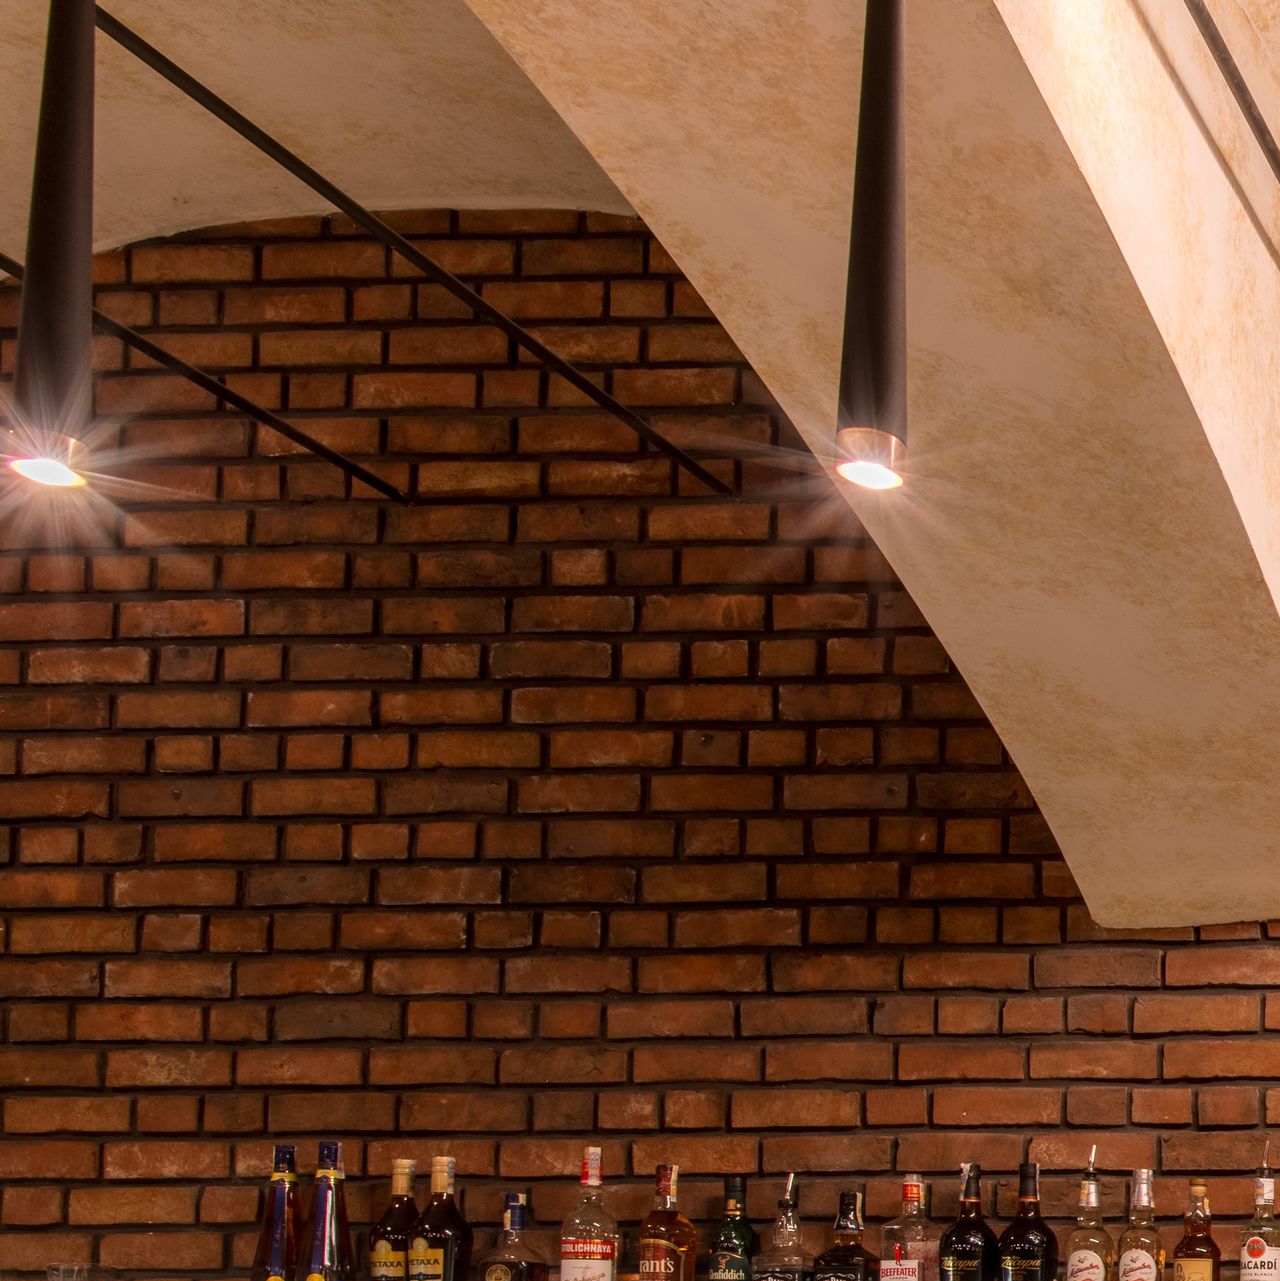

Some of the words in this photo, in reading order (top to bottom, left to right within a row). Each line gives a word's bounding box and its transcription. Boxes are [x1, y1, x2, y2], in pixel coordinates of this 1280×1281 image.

[561, 1243, 612, 1253] STOLICHNAYA
[640, 1257, 674, 1273] rant's
[881, 1267, 917, 1278] BEEFEATER
